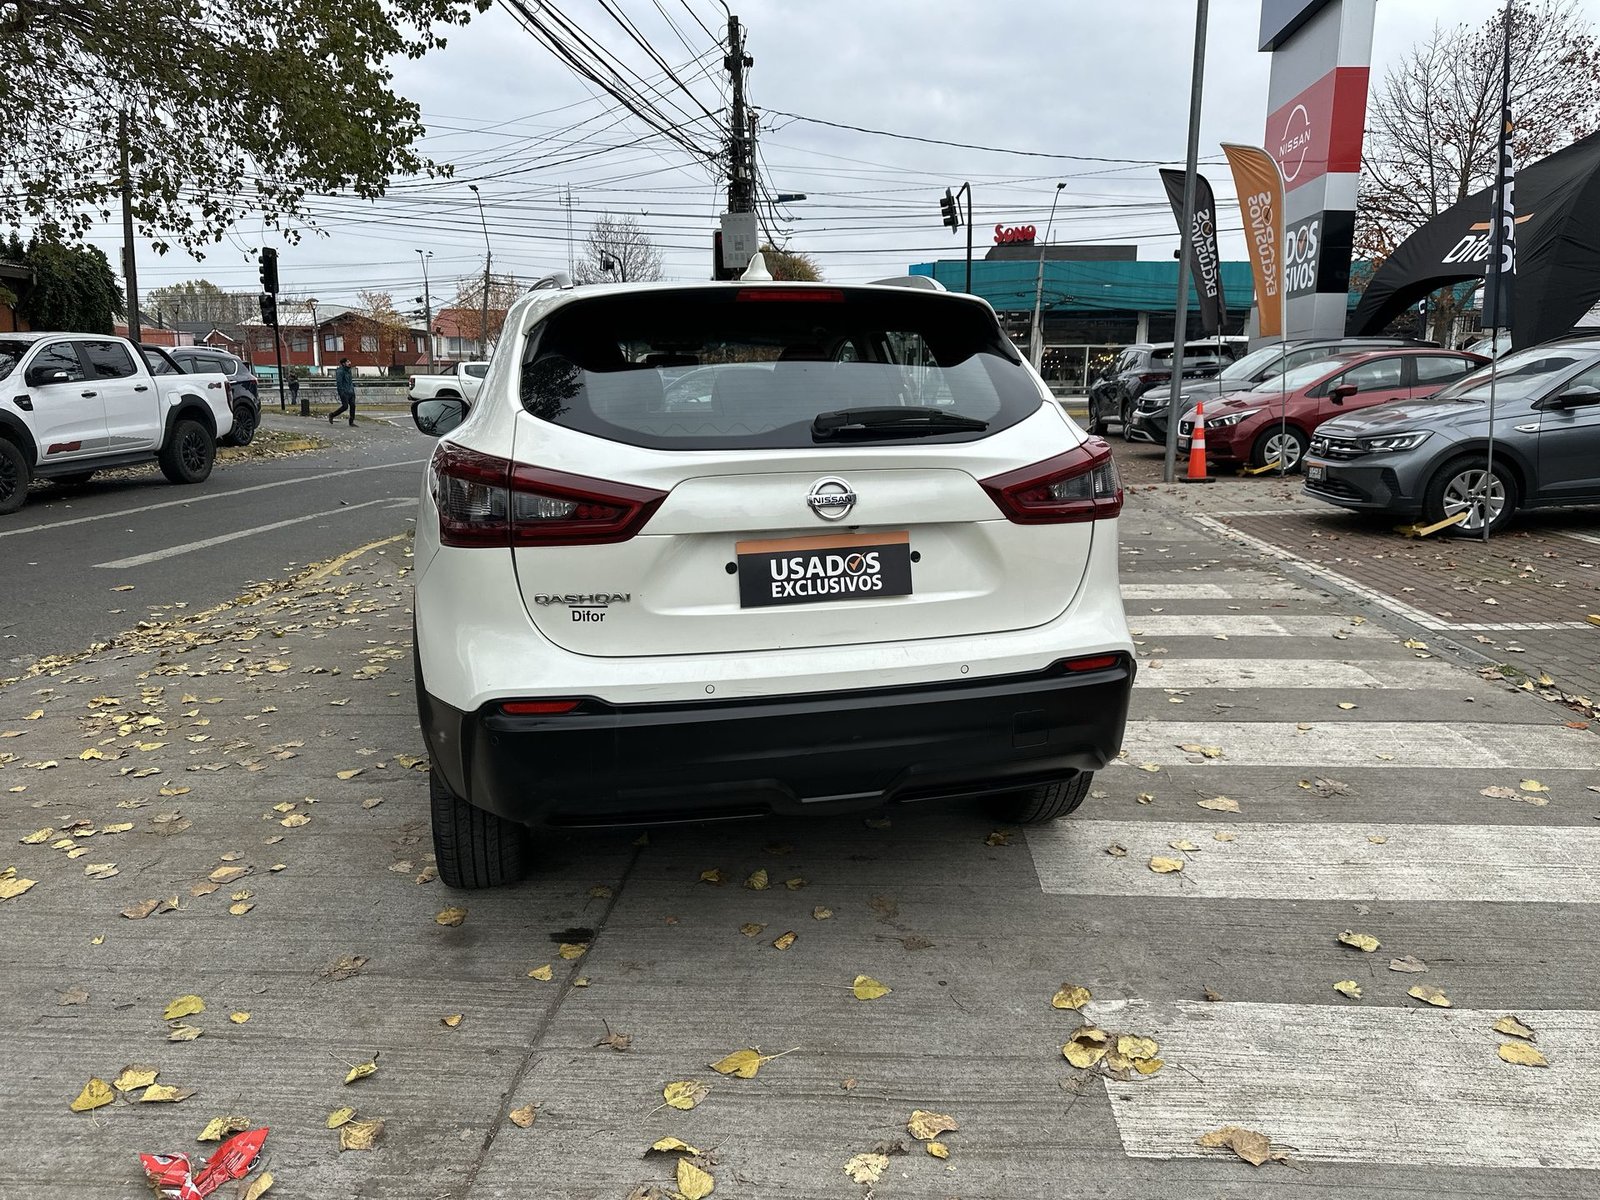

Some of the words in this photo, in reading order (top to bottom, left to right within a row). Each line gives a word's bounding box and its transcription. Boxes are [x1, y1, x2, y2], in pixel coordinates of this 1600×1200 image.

[1279, 129, 1312, 157] NISSAN
[1286, 220, 1319, 266] DOS
[1441, 234, 1490, 263] Difo
[1285, 260, 1316, 293] SIVOS
[812, 495, 853, 505] NISSAN
[770, 552, 881, 581] USADOS
[534, 592, 631, 606] QASHQAI
[771, 574, 883, 598] EXCLUSIVOS
[571, 610, 606, 622] Difor
